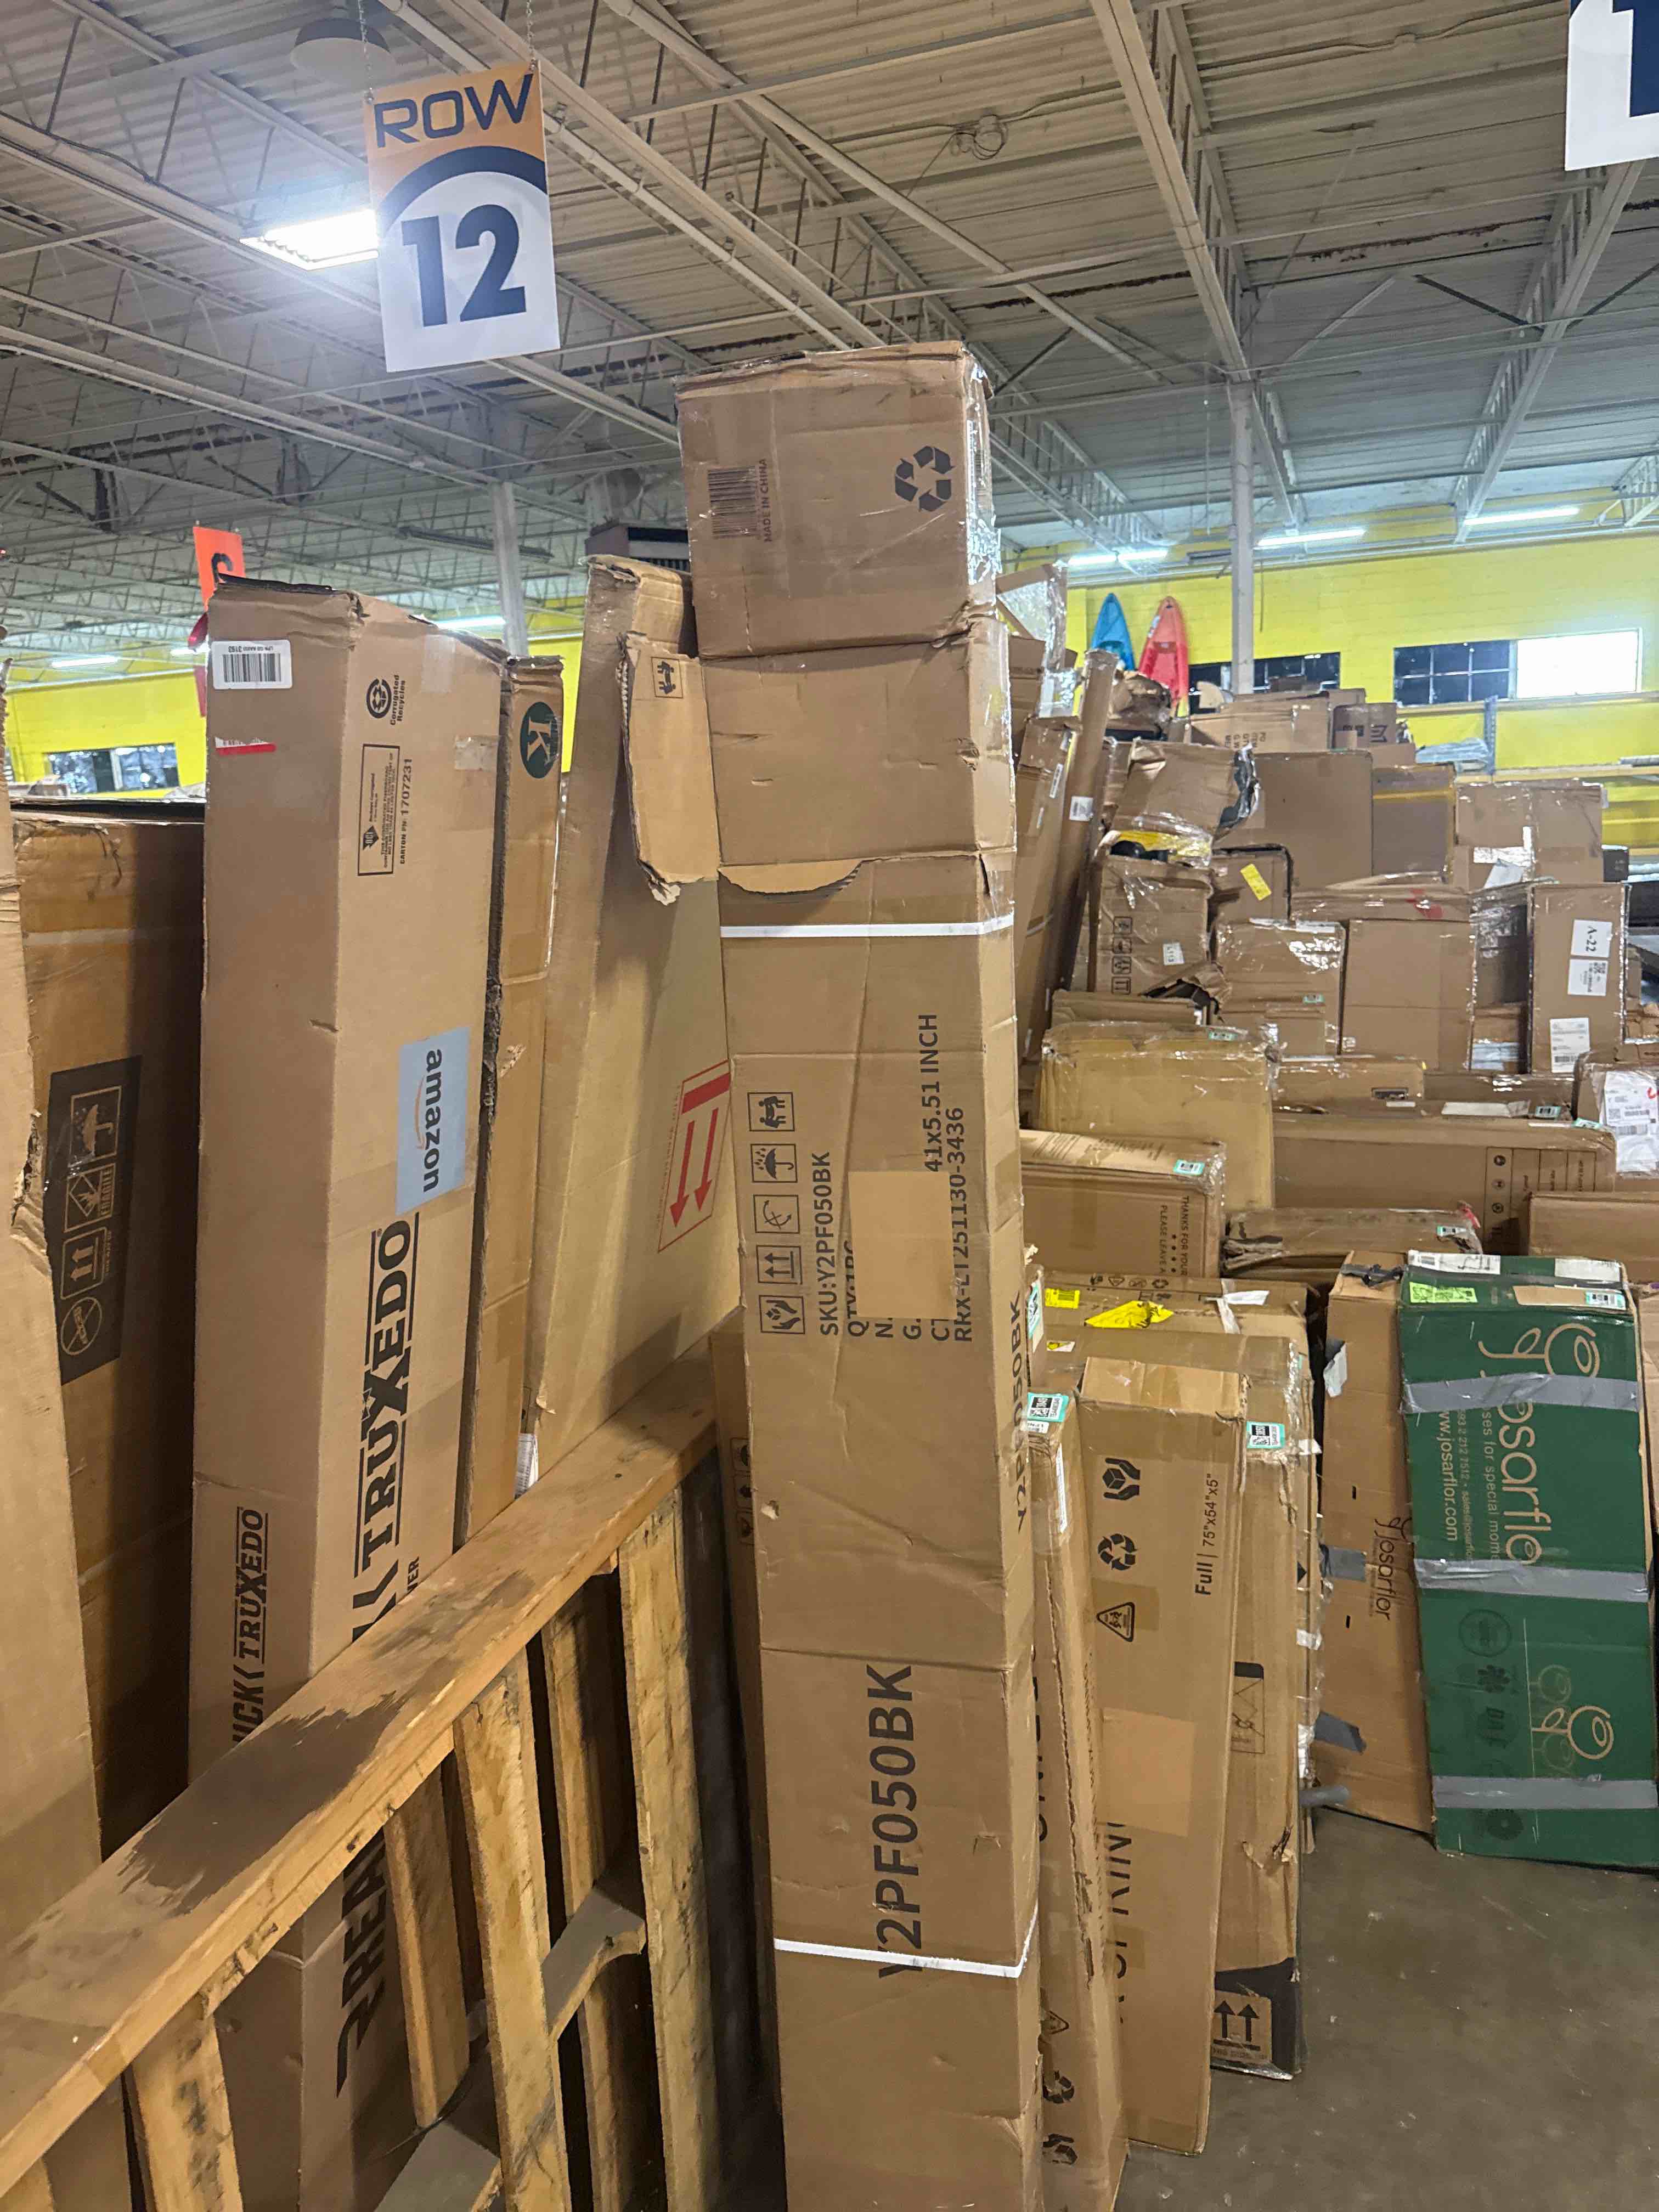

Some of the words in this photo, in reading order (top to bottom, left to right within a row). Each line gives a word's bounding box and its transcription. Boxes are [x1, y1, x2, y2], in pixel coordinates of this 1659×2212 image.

[374, 73, 534, 148] ROW
[401, 204, 527, 328] 12
[759, 458, 769, 494] CHINA
[761, 496, 770, 509] IN
[763, 510, 773, 543] MADE
[390, 674, 400, 726] Corrugated
[397, 680, 406, 722] Recycles
[400, 758, 413, 816] 1707231
[1585, 926, 1598, 952] A-22
[918, 1014, 940, 1073] INCH
[423, 1048, 443, 1193] amazon
[921, 1081, 942, 1172] 41x5.51
[1159, 1205, 1168, 1235] PLEASE
[1181, 1195, 1189, 1231] THANKS
[811, 1151, 839, 1336] SKU:Y2PF050BK
[1159, 1239, 1167, 1265] LEAVE
[1180, 1233, 1188, 1250] FOR
[360, 1220, 411, 1572] TRUXEDO
[1436, 1410, 1458, 1541] ww.josarflor.com
[1483, 1441, 1497, 1462] for
[1202, 1473, 1218, 1547] 75"x54"x5"
[1483, 1464, 1500, 1516] special
[235, 1509, 268, 1660] TRUXEDO
[1194, 1562, 1213, 1595] Full
